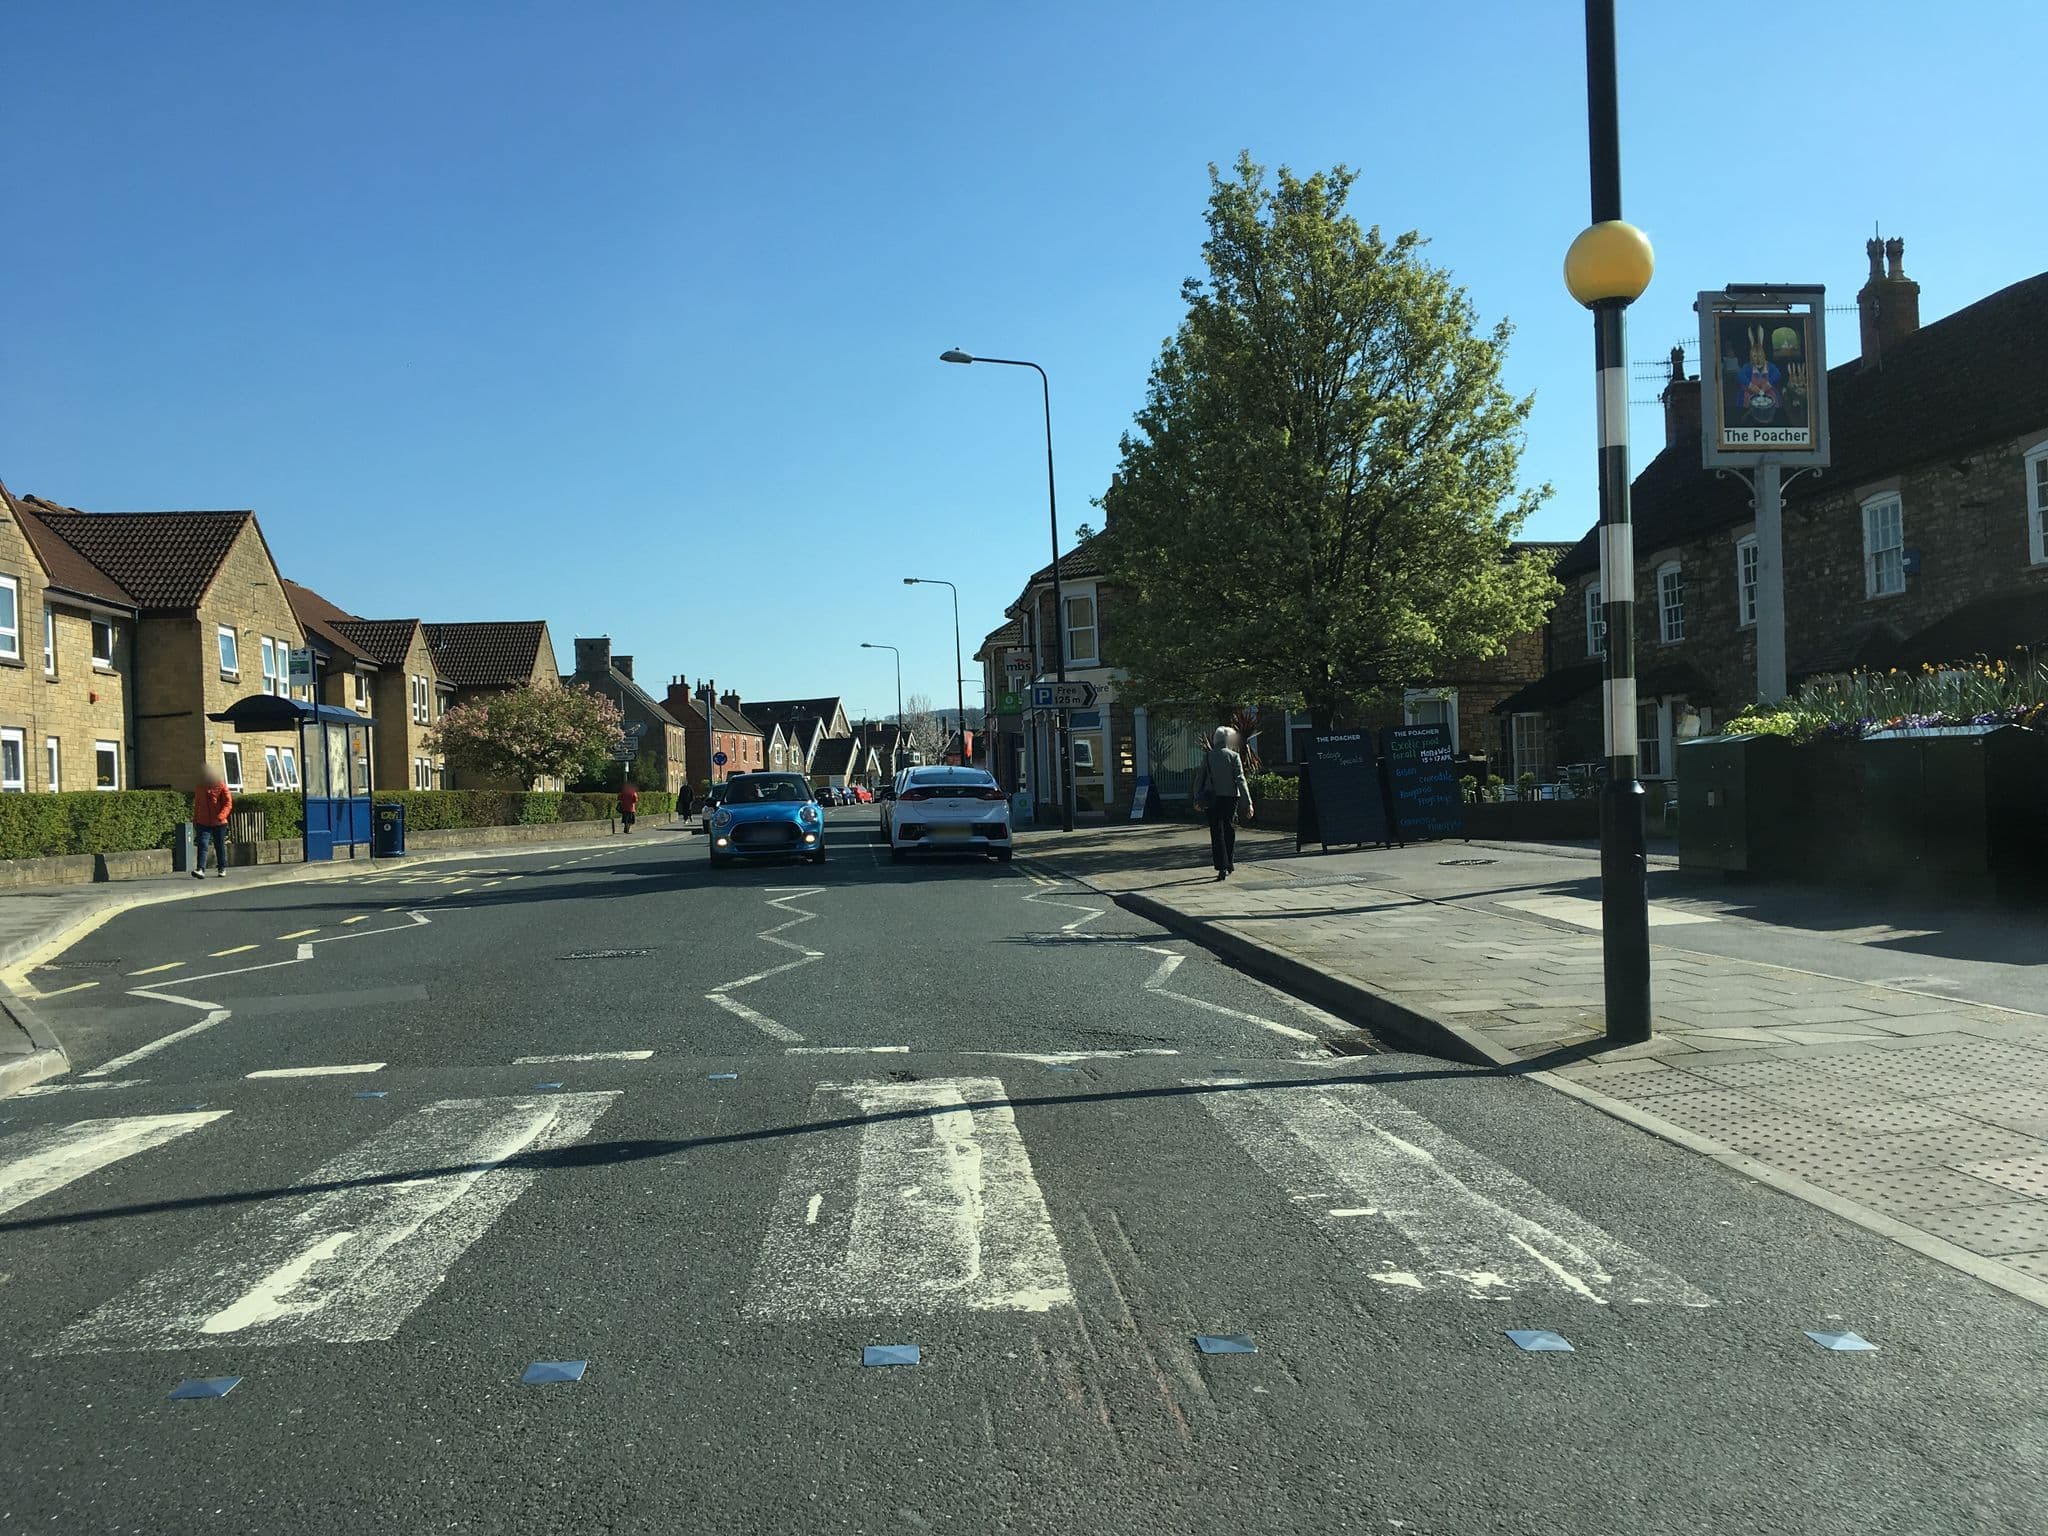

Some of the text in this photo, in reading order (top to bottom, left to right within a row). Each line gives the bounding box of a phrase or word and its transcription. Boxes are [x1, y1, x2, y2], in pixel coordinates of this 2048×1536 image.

[1724, 428, 1808, 442] The Poacher
[1006, 662, 1031, 671] mbs
[1057, 686, 1077, 695] Free
[1393, 728, 1439, 738] THE POACHER
[1330, 734, 1361, 742] POACHER
